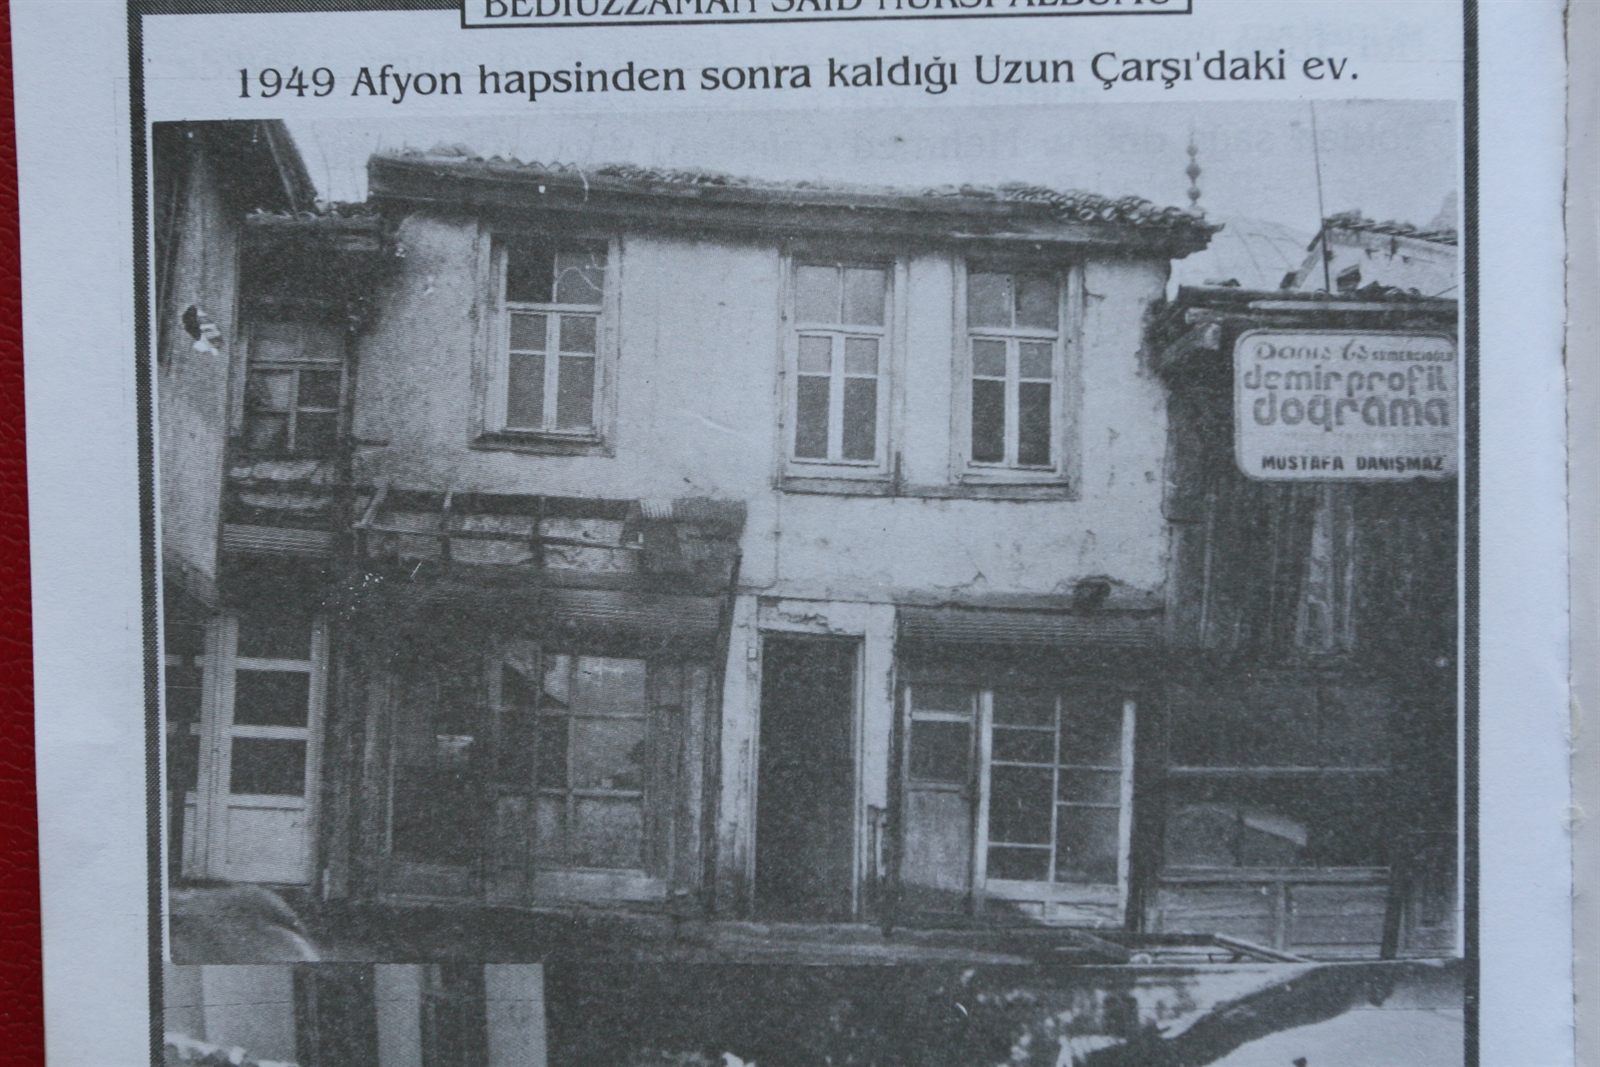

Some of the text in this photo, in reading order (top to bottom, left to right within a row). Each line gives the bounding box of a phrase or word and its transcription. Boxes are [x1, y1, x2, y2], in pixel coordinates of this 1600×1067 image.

[239, 48, 1358, 104] 1949 Afyon hapsinden sonra kaldığı Uzun Çarşı'daki ev.
[1243, 364, 1449, 398] demir profil
[1261, 455, 1345, 472] MUSTAFA
